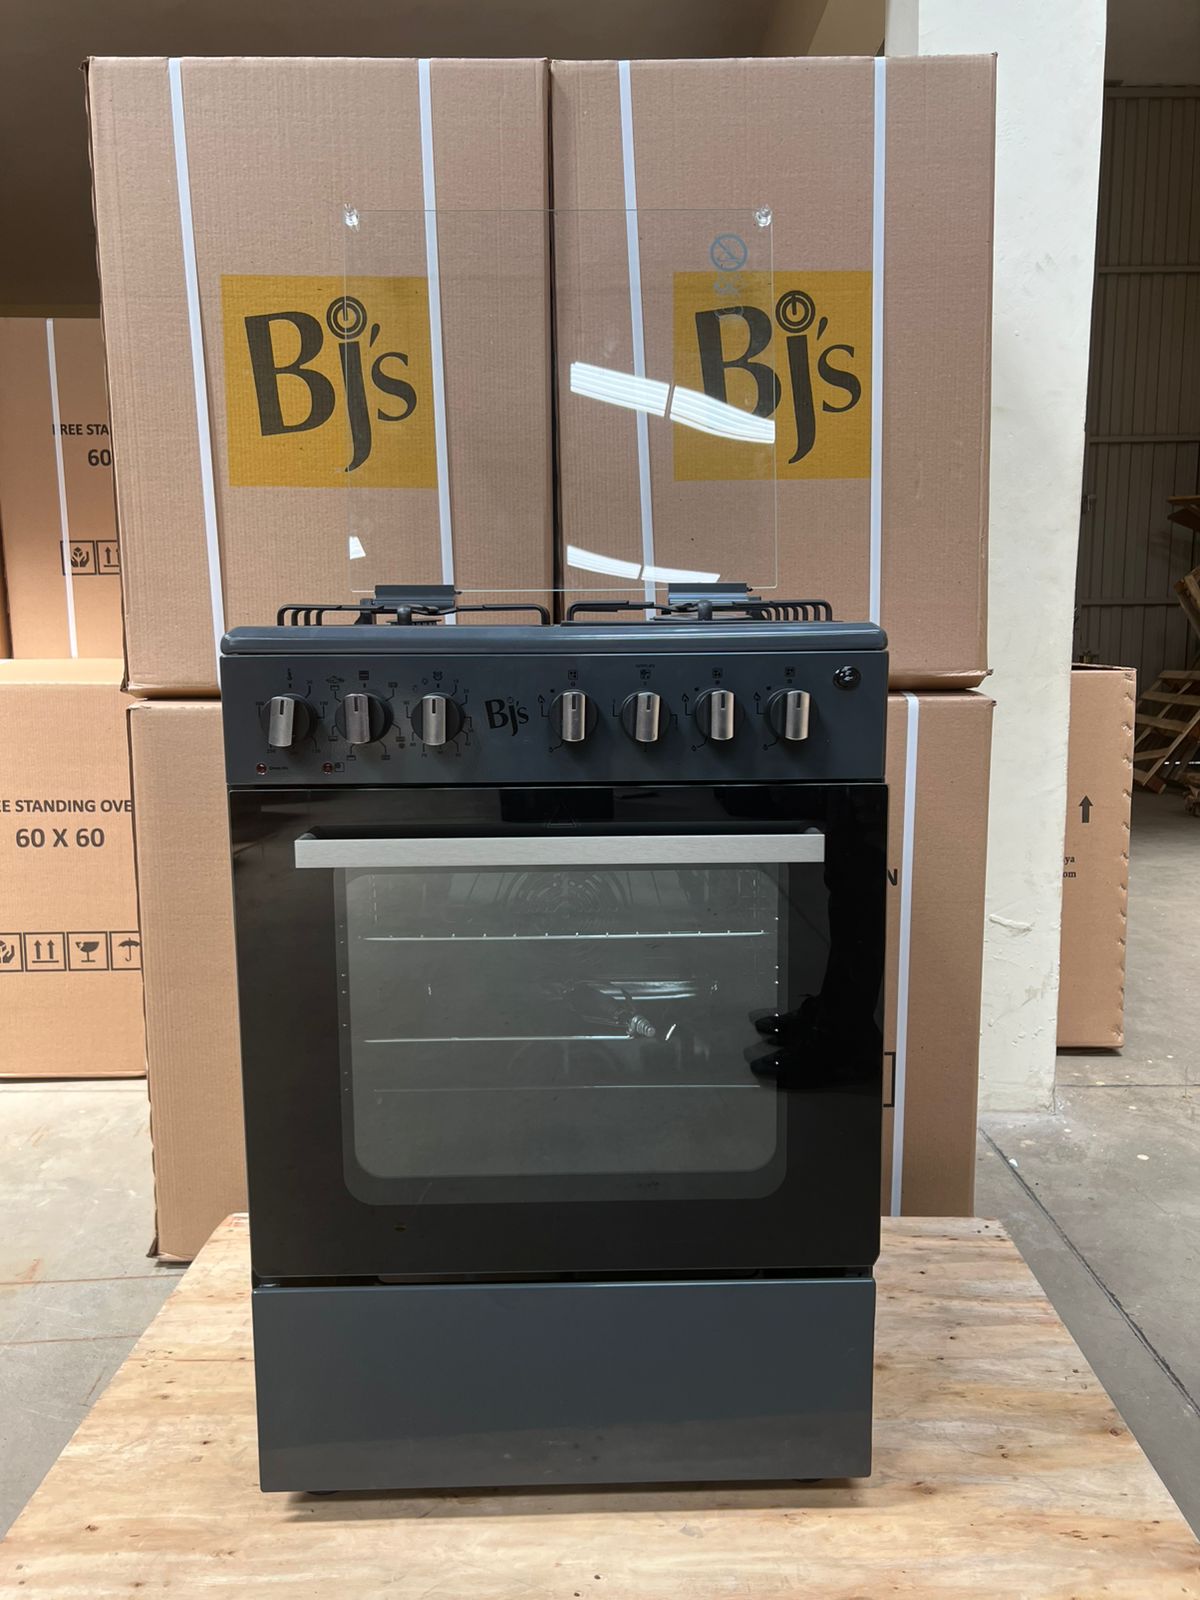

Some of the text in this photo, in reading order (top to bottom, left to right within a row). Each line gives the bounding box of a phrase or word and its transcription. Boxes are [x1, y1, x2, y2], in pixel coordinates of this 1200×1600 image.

[244, 295, 418, 473] Bj's
[86, 423, 109, 436] STA
[87, 448, 112, 467] 60
[484, 695, 530, 737] Bj's
[15, 799, 96, 813] STANDING
[15, 828, 105, 848] 60 X 60
